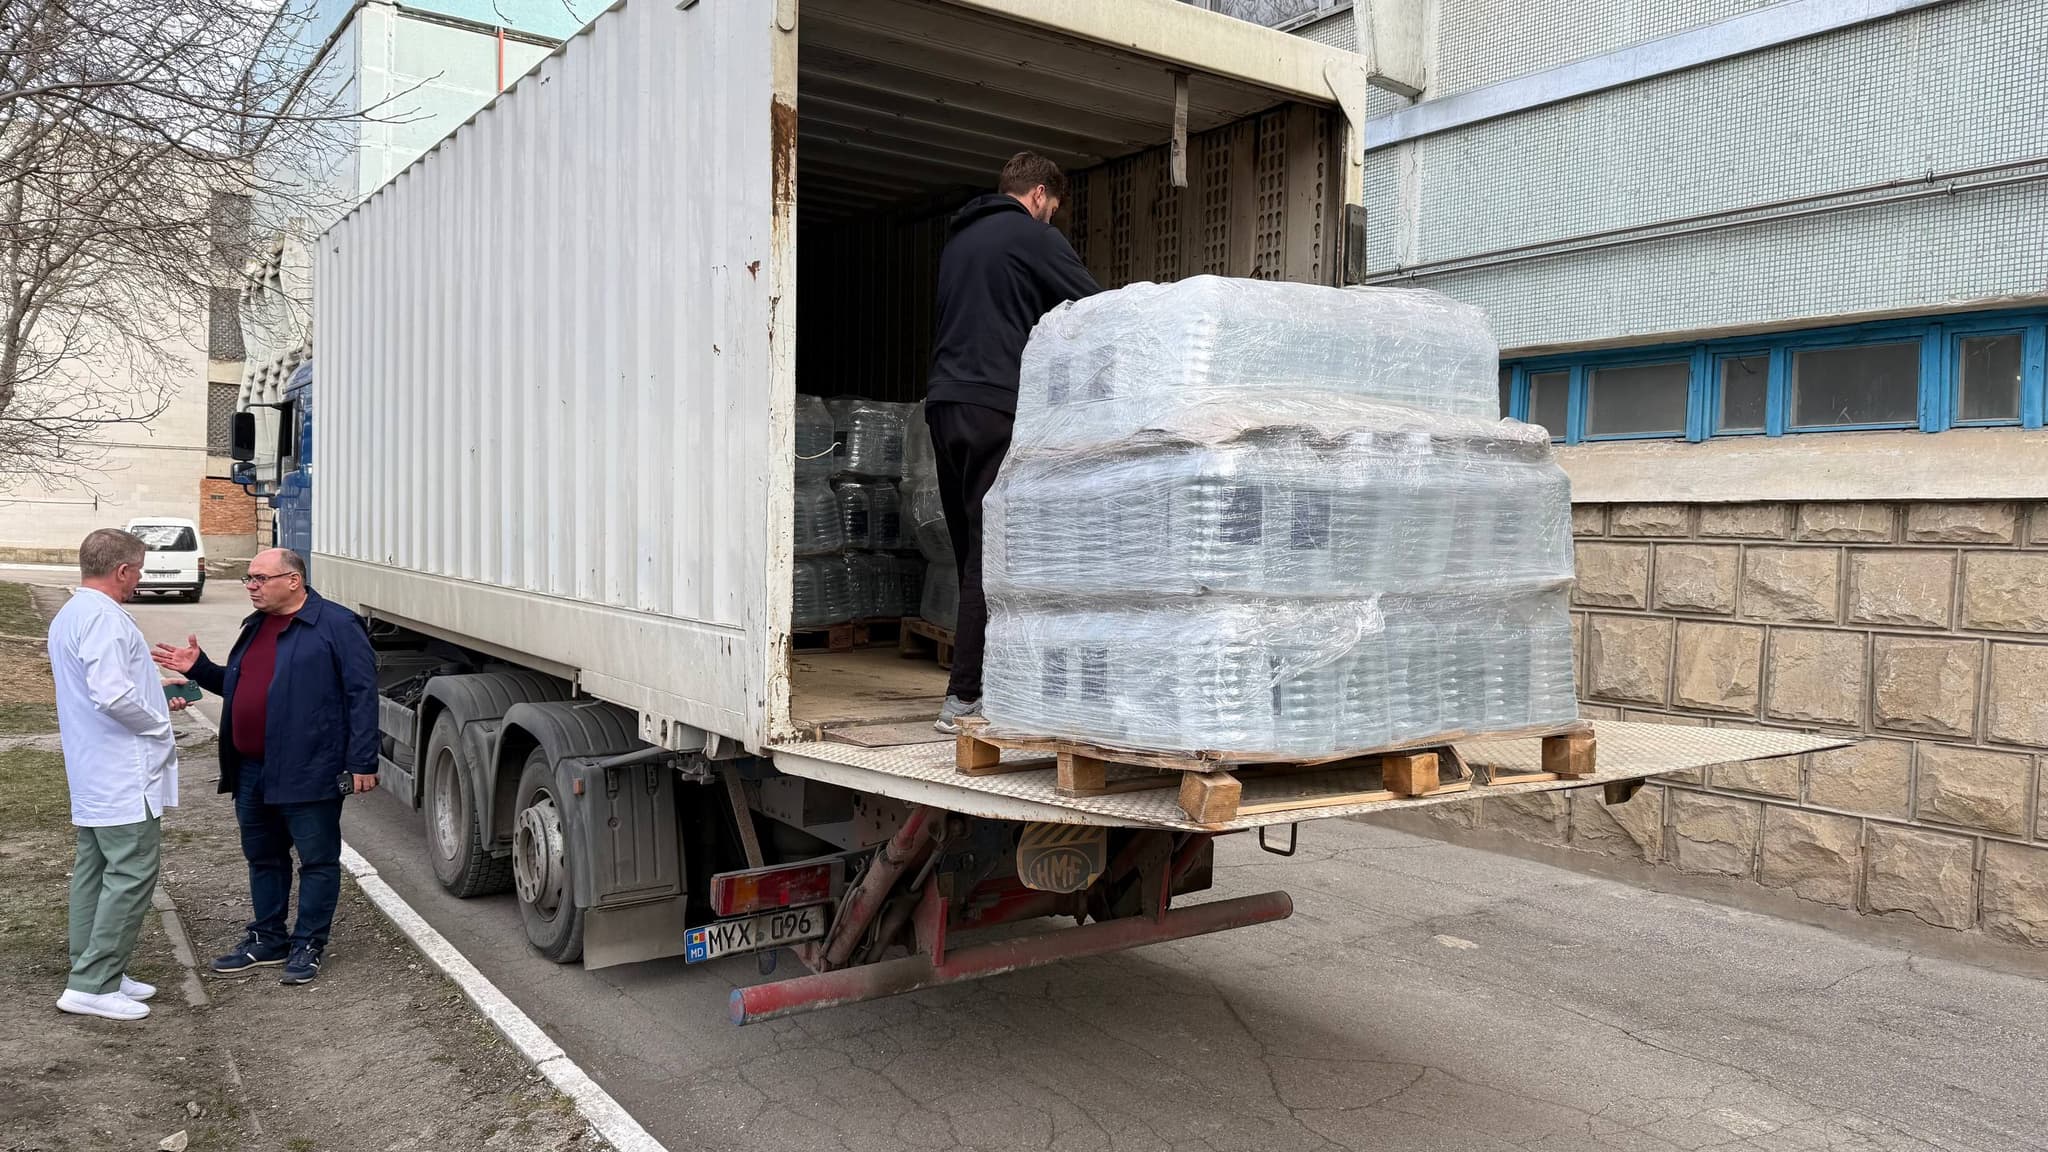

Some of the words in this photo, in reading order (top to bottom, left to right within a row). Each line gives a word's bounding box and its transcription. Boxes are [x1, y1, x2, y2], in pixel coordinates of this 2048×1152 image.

[1036, 854, 1083, 889] HMF
[690, 947, 704, 959] MD
[708, 922, 752, 954] MYX
[771, 911, 812, 940] 096
